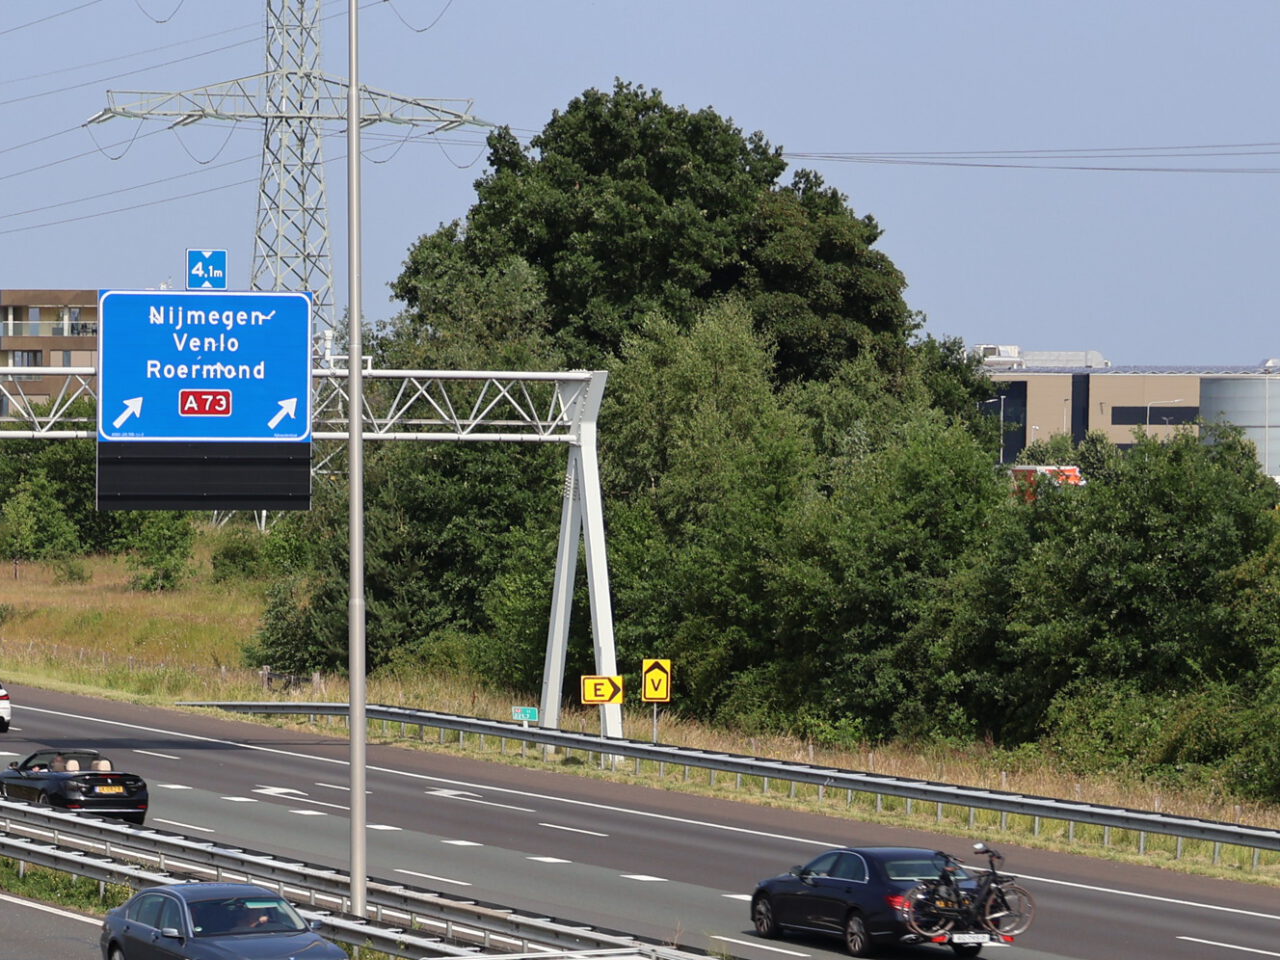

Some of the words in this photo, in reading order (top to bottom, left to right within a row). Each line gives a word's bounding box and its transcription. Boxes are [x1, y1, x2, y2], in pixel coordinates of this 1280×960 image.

[149, 305, 264, 331] Nijmegen
[172, 332, 240, 352] Venlo
[146, 359, 266, 380] Roermond
[183, 394, 228, 411] A73
[593, 682, 606, 698] E
[650, 678, 662, 692] V
